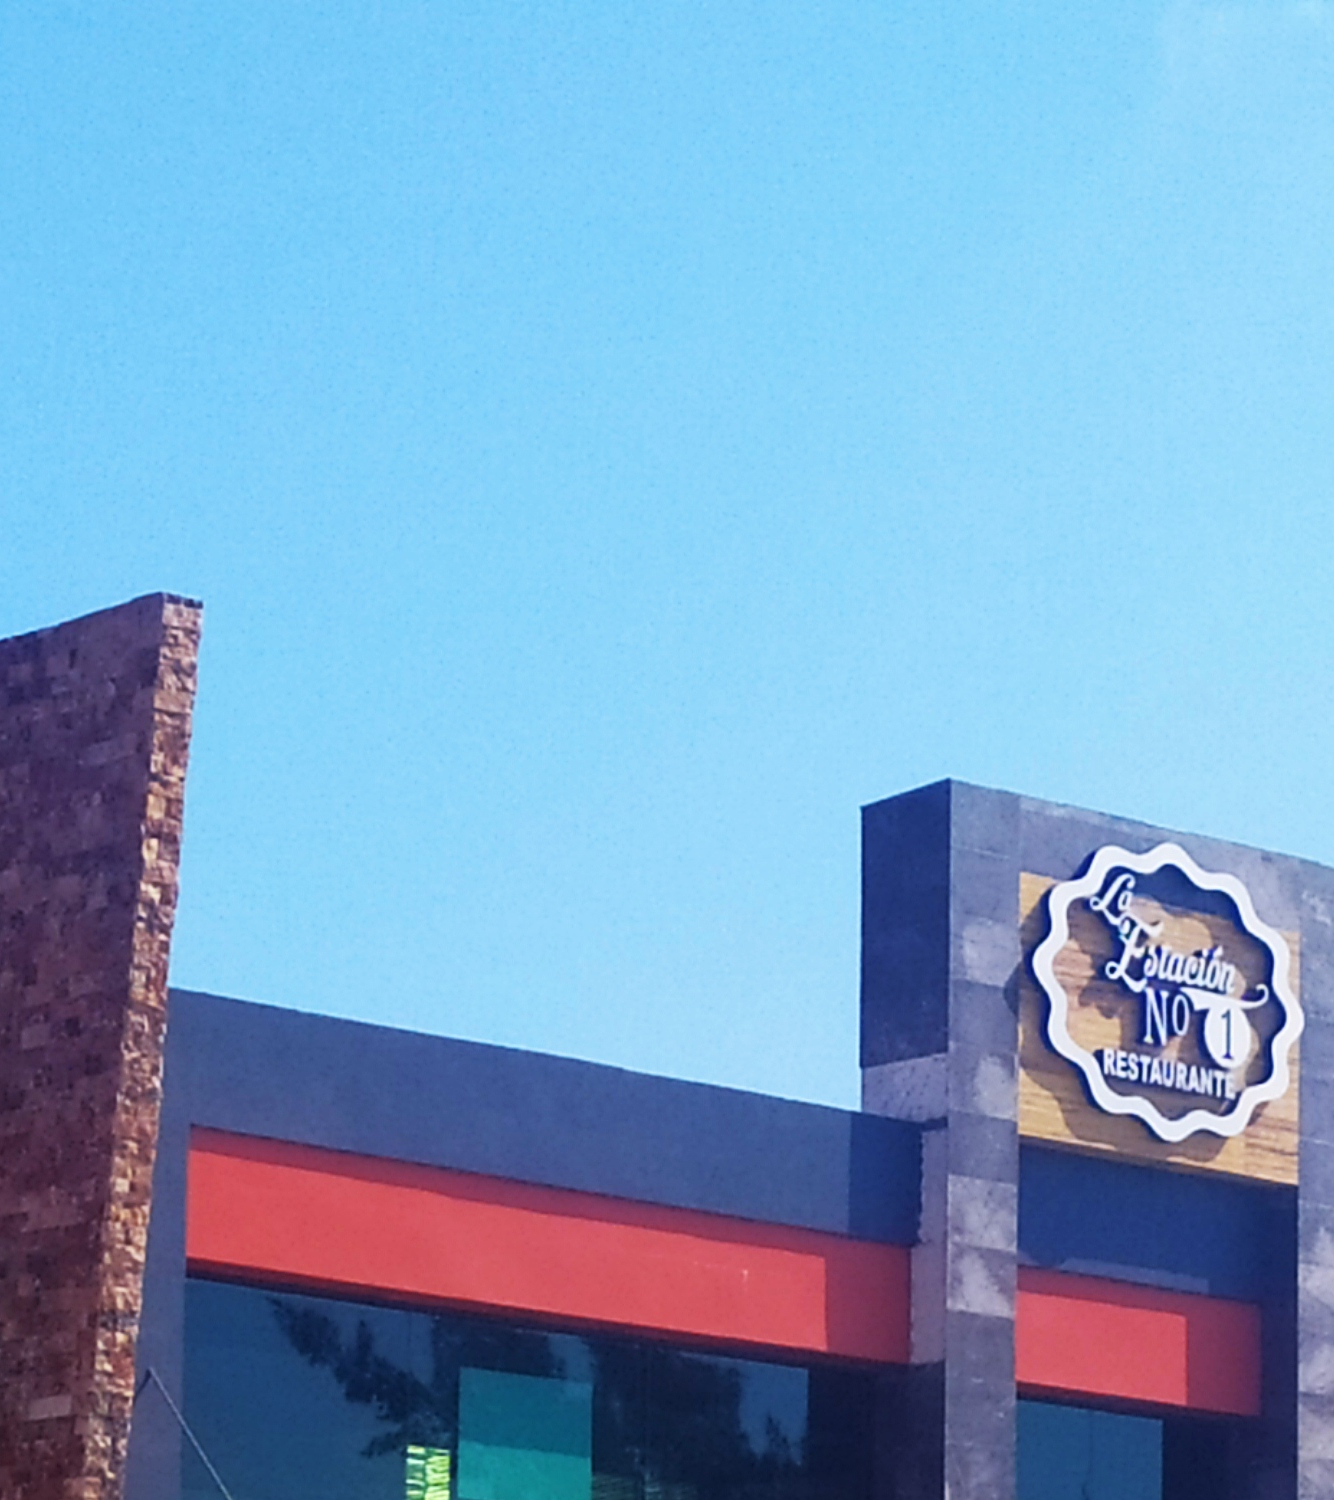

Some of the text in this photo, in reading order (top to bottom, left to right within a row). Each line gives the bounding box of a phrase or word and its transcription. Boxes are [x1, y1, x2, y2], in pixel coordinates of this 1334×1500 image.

[1089, 873, 1136, 926] La
[1105, 911, 1237, 994] Estación
[1102, 1048, 1237, 1100] RESTAURANTE
